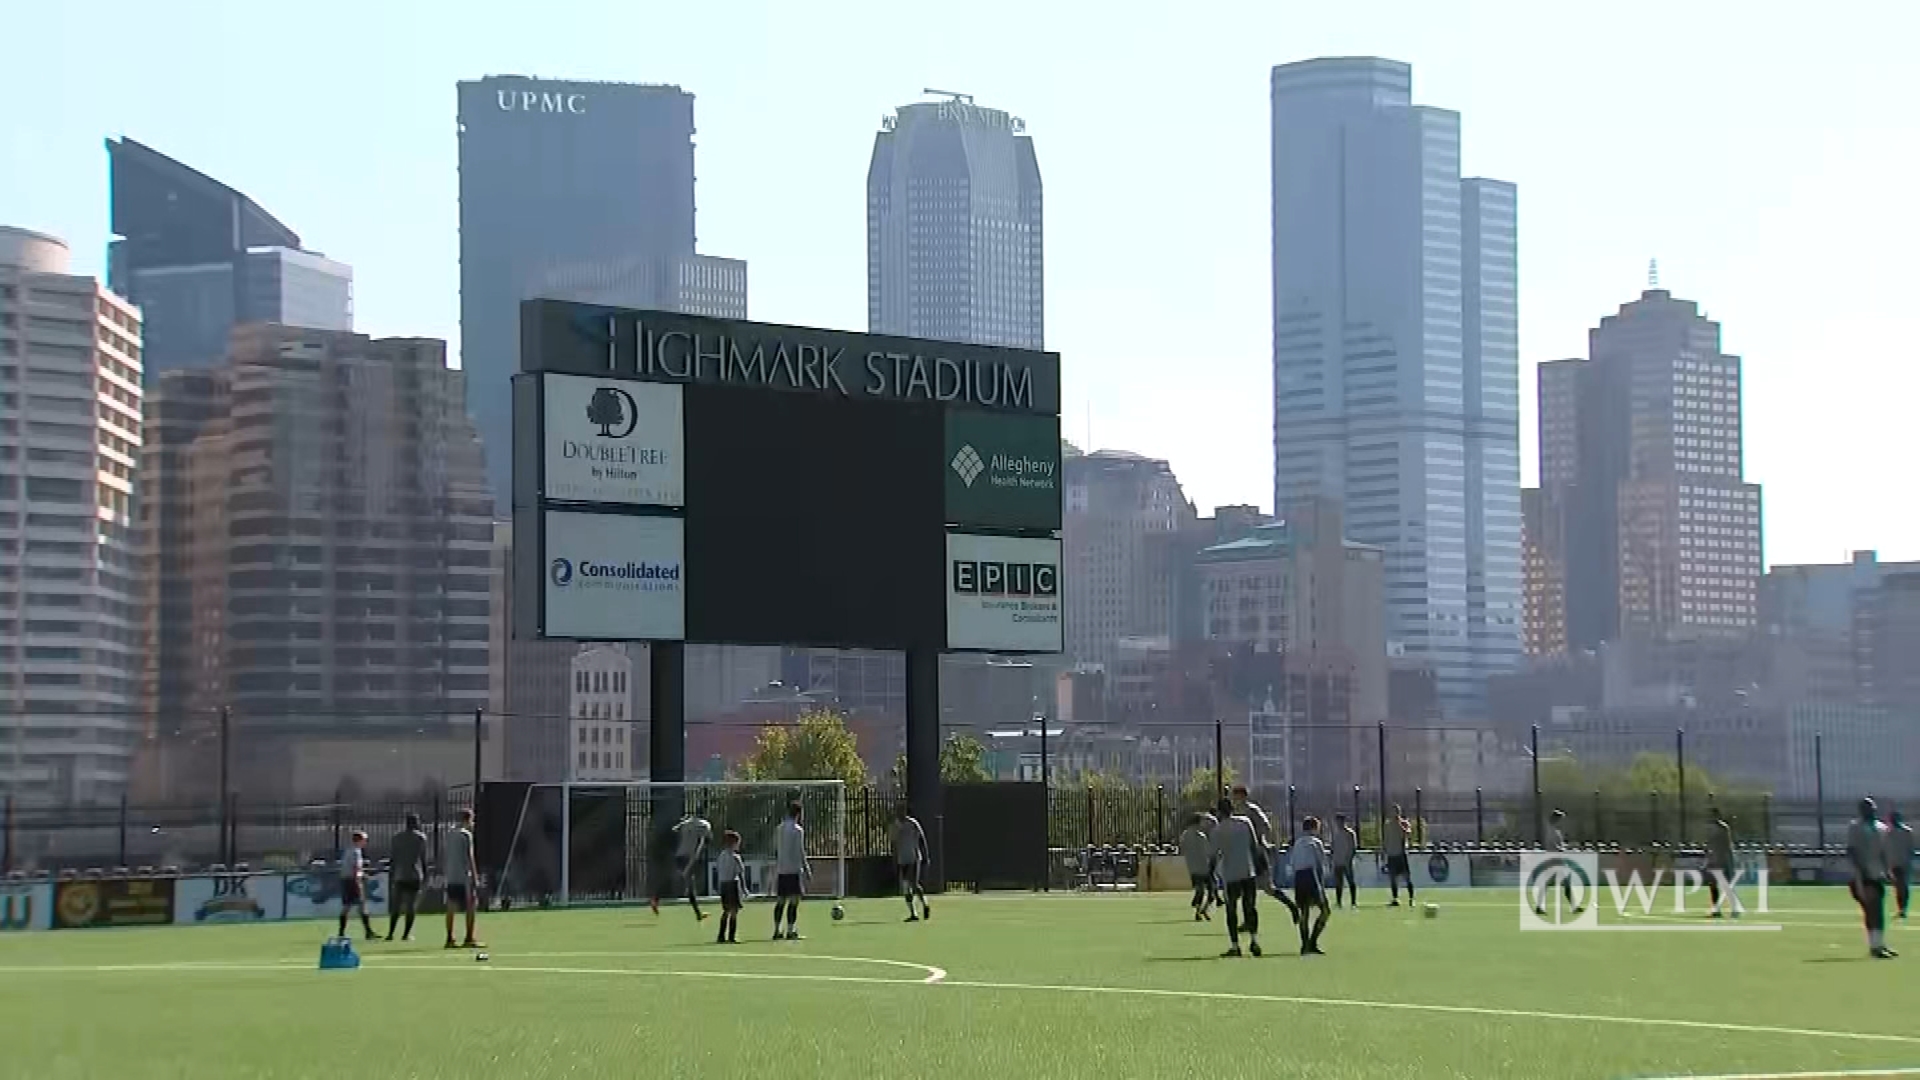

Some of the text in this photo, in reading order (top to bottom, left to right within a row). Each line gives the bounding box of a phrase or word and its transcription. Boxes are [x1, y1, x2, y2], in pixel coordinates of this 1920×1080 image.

[497, 90, 586, 114] UPMC
[609, 316, 1033, 408] HIGHMARK STADIUM
[606, 467, 637, 479] Hilton
[991, 454, 1055, 476] Allegheny
[579, 561, 679, 580] Consolidated
[957, 563, 1053, 592] EPIC
